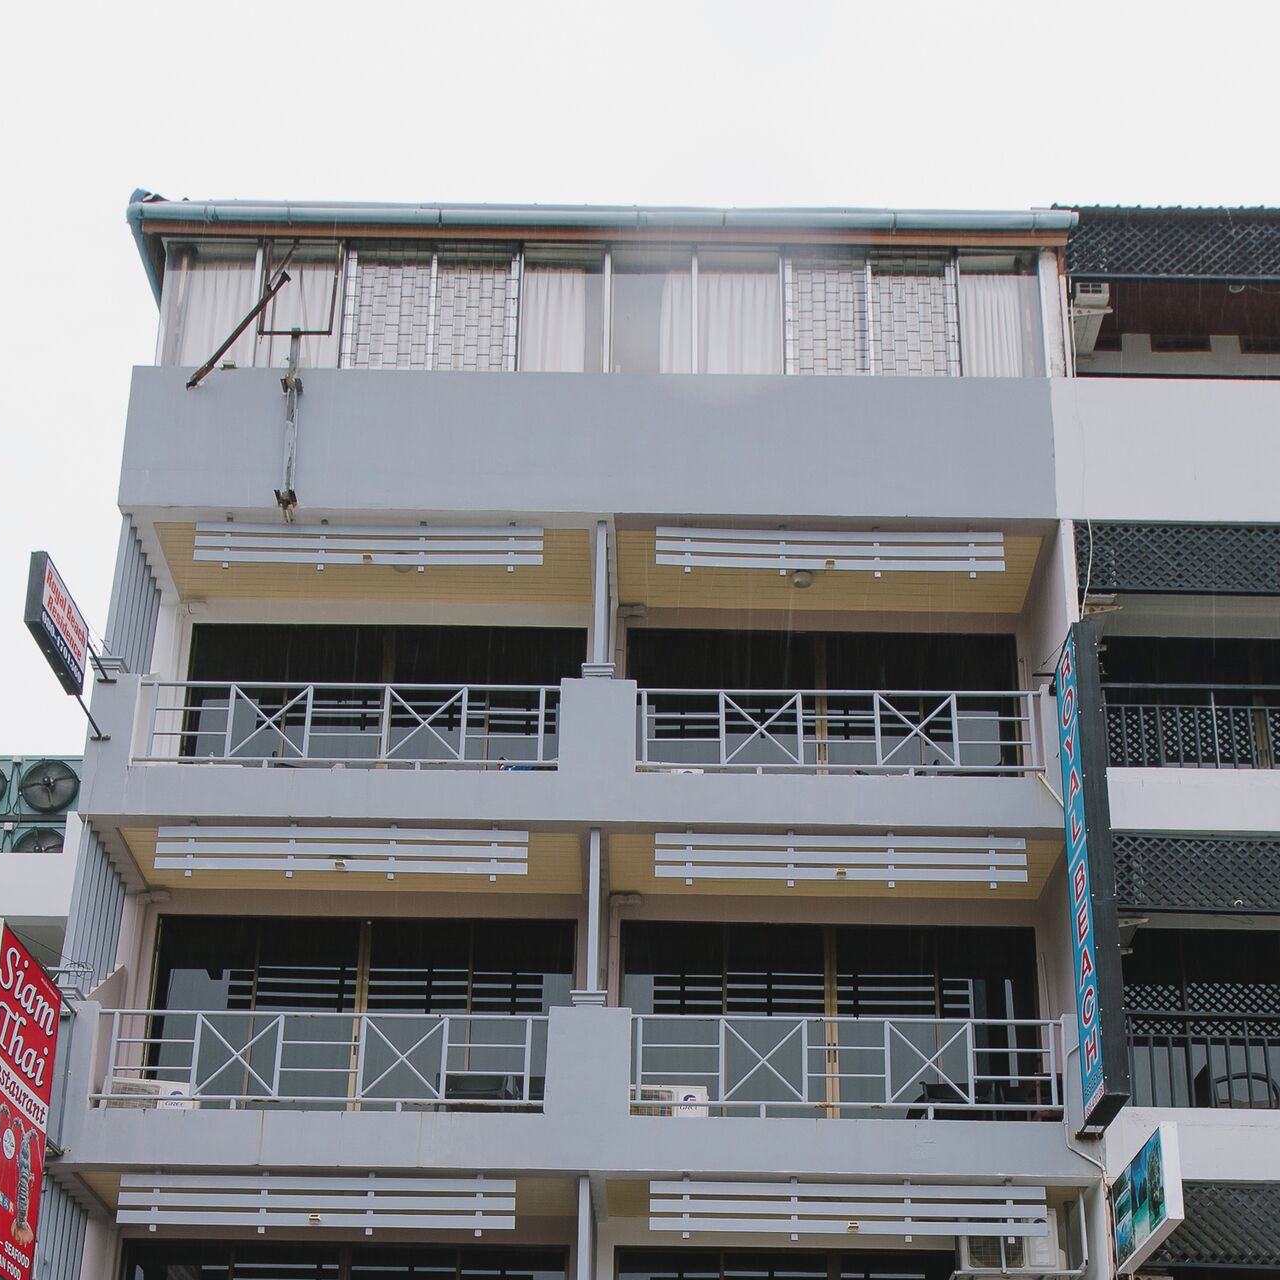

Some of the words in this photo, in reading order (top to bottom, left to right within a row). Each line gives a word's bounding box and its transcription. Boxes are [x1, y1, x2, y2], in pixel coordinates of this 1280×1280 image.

[46, 569, 67, 612] Royal
[66, 604, 86, 648] Beach
[47, 595, 81, 661] Residence
[1059, 649, 1082, 848] ROYAL
[1073, 860, 1098, 1076] BEACH
[4, 1241, 30, 1269] SEAFOOD
[7, 1260, 21, 1280] FOOD
